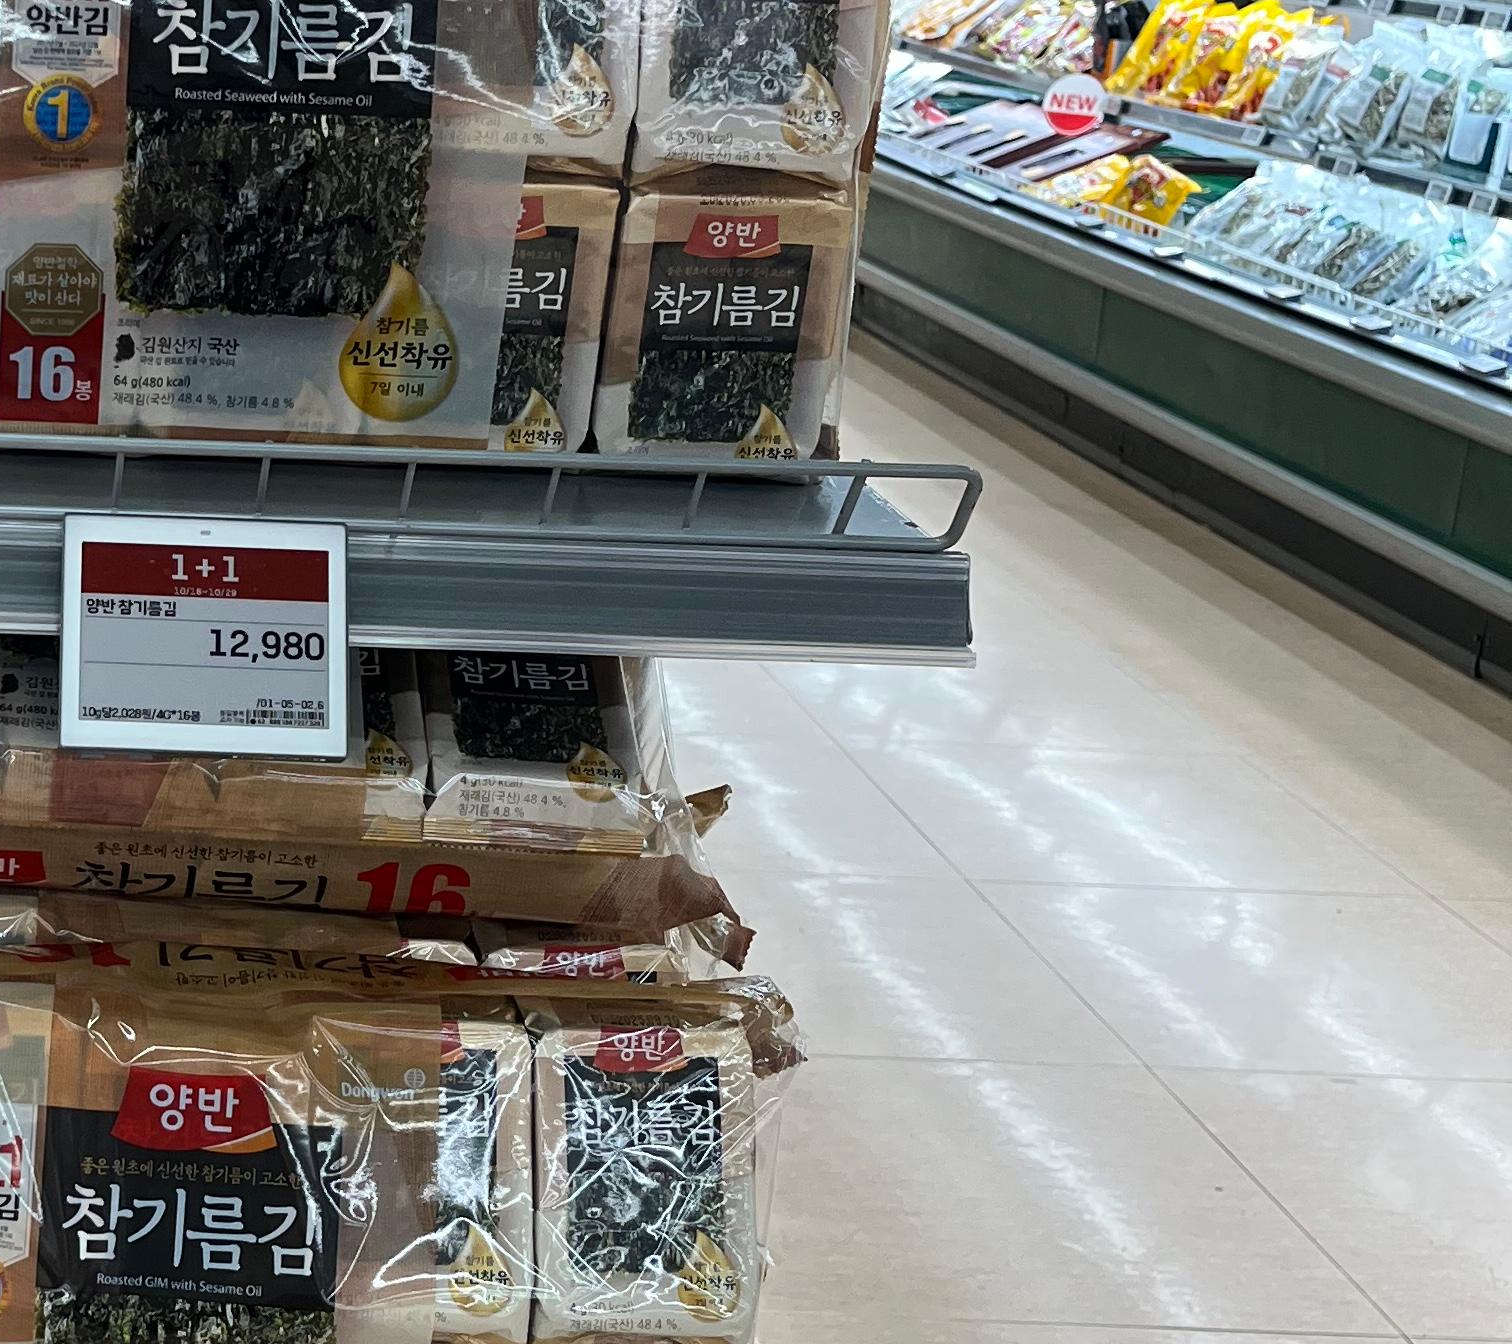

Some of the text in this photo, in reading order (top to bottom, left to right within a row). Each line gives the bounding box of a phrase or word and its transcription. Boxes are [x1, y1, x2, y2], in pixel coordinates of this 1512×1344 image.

[175, 88, 372, 108] Roasted Seaweed with Sesame Oil
[1049, 91, 1097, 114] NEW
[651, 281, 801, 330] 참기름김
[376, 315, 429, 336] 참기름
[142, 336, 240, 356] 김원산지 국산
[369, 379, 425, 399] 7일 이내
[172, 554, 239, 582] 1+1
[86, 598, 177, 617] 양반 참기름김
[209, 628, 325, 664] 12,980
[341, 1081, 416, 1101] Dongwon
[80, 1157, 303, 1191] 좋은 원초에 신선한 참기름이 고소한
[62, 1182, 320, 1279] 참기름김
[96, 1272, 263, 1298] Roasted GIM with Sesame Oil
